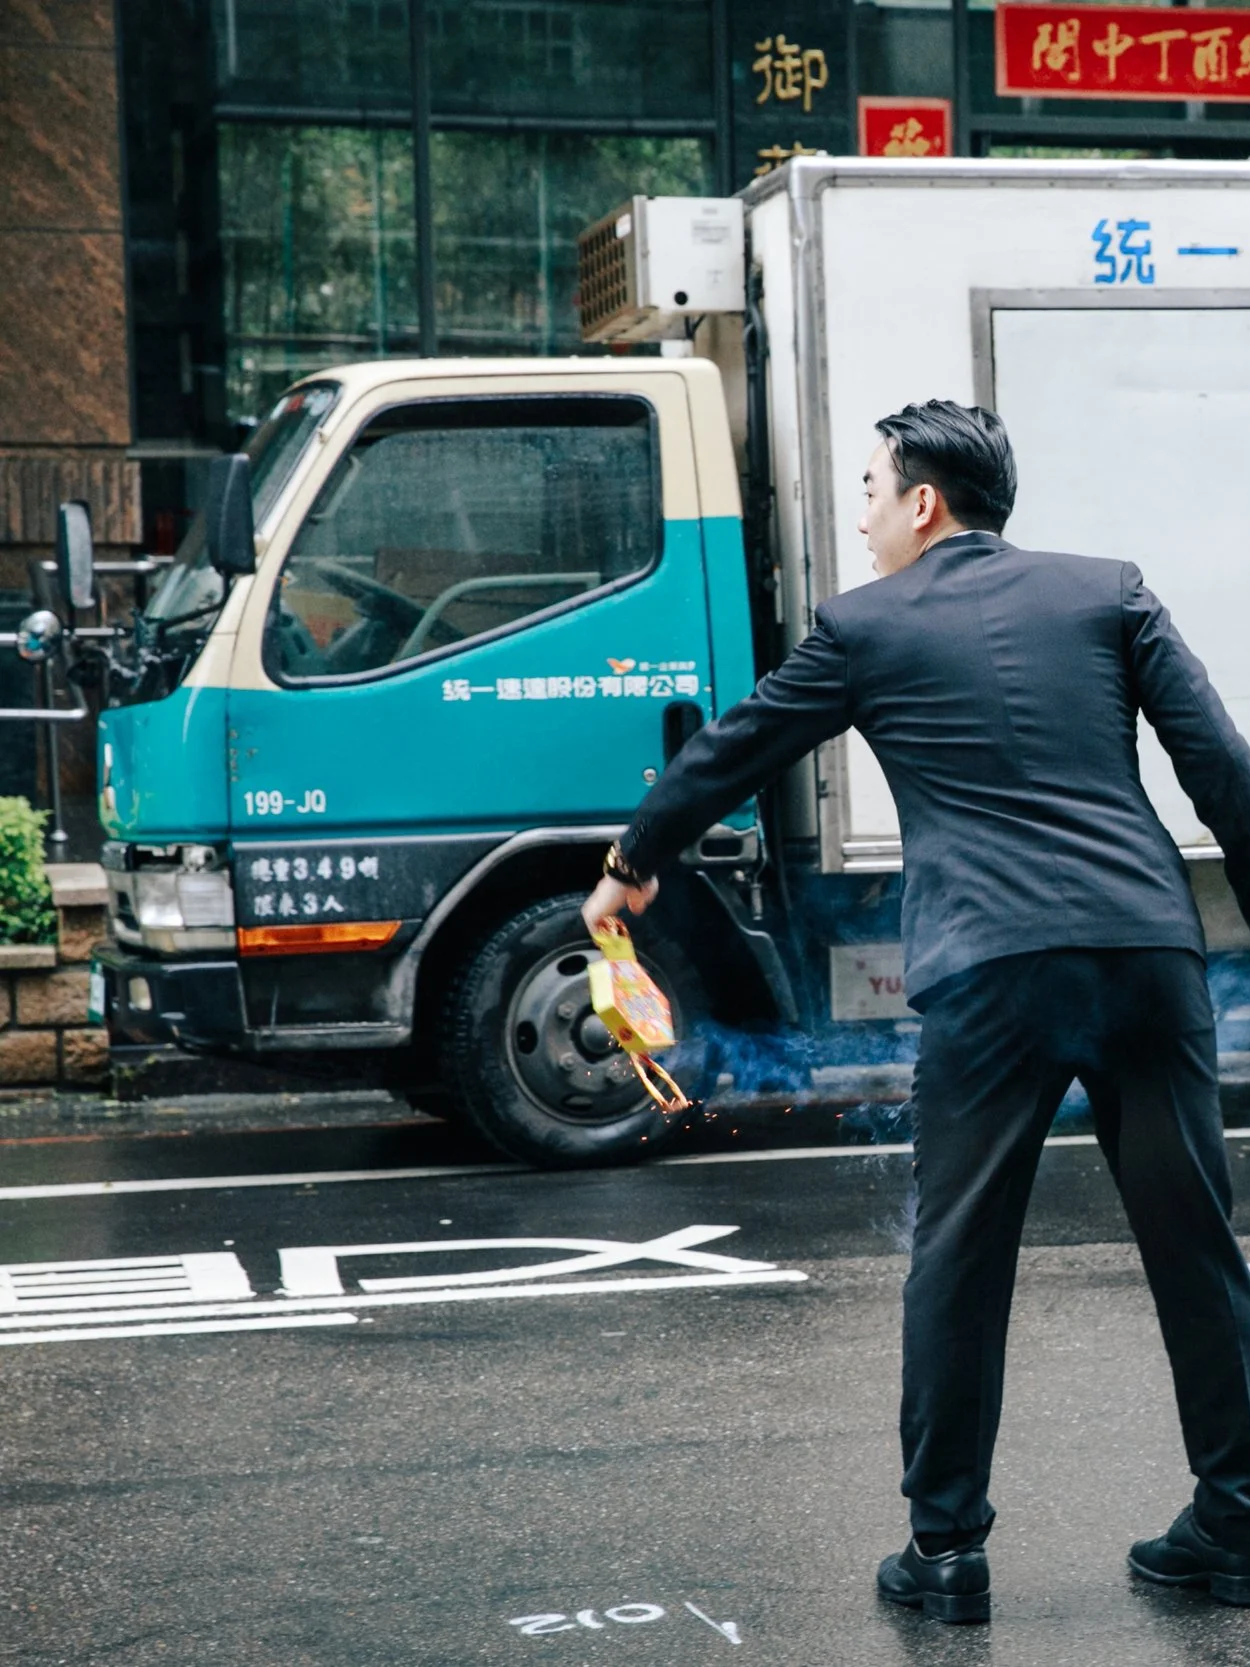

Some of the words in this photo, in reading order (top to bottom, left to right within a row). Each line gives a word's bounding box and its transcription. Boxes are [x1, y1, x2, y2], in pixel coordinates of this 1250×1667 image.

[442, 674, 699, 701] 統一速達股份有限公司
[244, 789, 326, 816] 199-JQ
